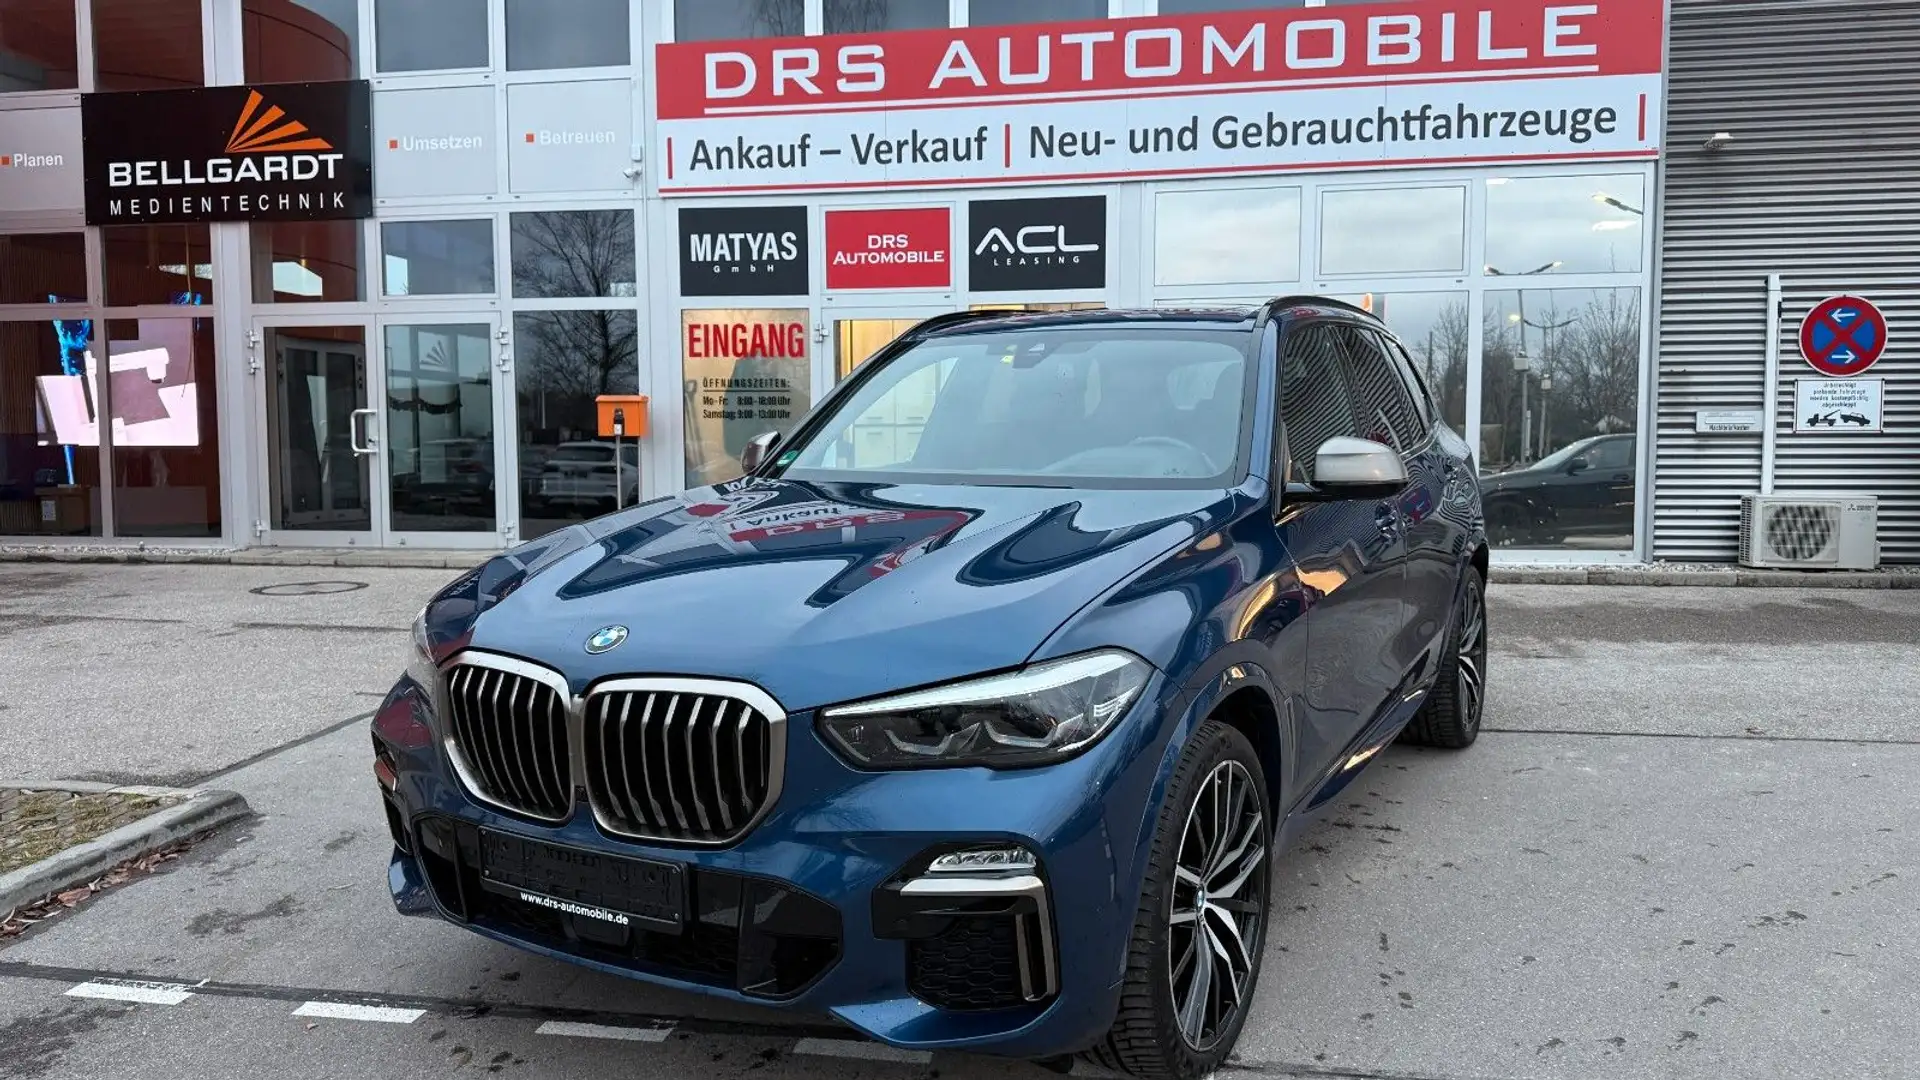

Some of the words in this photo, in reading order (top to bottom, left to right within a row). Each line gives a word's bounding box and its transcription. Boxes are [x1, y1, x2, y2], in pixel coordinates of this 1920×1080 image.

[704, 44, 886, 99] DRS
[928, 4, 1599, 90] AUTOMOBILE
[403, 135, 483, 151] Umsetzen
[539, 129, 616, 145] Betreuen
[689, 133, 811, 171] Ankauf
[850, 125, 988, 165] Verkauf
[1029, 124, 1116, 159] Neu-
[1128, 116, 1199, 154] und
[1212, 102, 1618, 150] Gebrauchtfahrzeuge
[13, 152, 63, 168] Planen
[108, 153, 344, 187] BELLGARDT
[110, 191, 345, 216] MEDIENTECHNIK
[690, 231, 798, 262] MATYAS
[867, 234, 909, 249] DRS
[974, 224, 1100, 256] ACL
[993, 255, 1080, 267] LEASING
[688, 323, 804, 358] EINGANG
[703, 377, 790, 388] ÖFFNUNGSZEITEN:
[520, 891, 629, 926] www.drs-automobile.de
